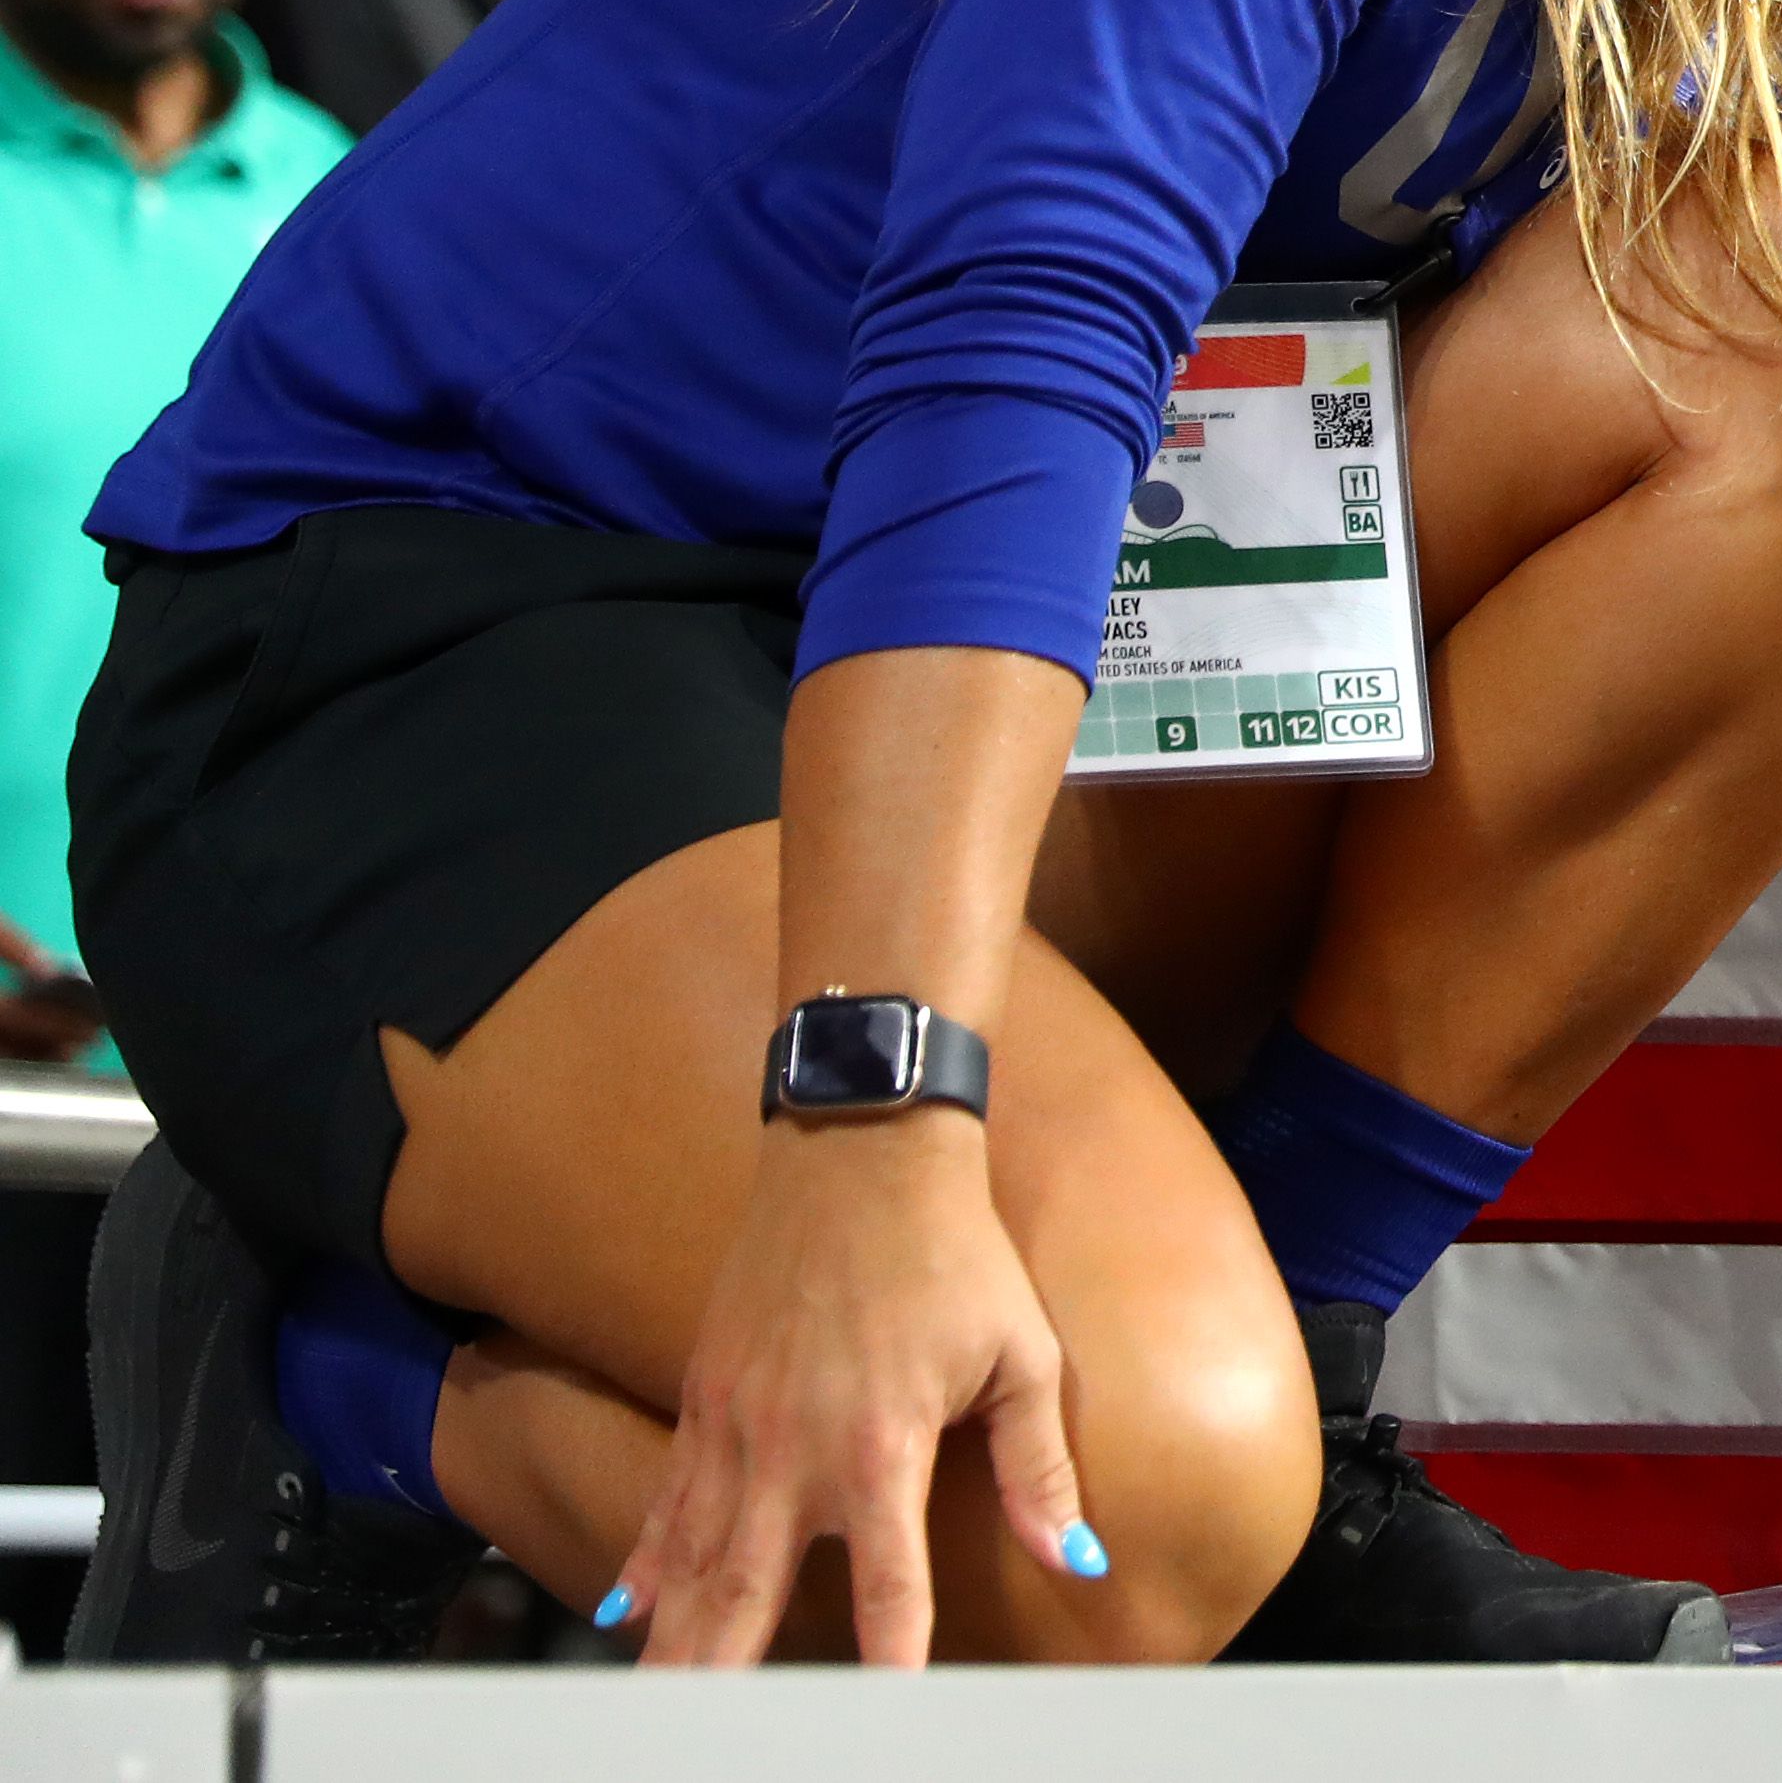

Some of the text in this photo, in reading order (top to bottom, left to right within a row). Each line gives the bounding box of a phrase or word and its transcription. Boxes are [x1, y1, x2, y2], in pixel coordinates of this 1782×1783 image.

[1209, 411, 1235, 420] AMERICA
[1347, 512, 1378, 533] BA
[1112, 645, 1152, 659] COACH
[1124, 661, 1168, 677] STATES
[1171, 661, 1184, 674] OF
[1189, 658, 1243, 673] AMERICA
[1334, 675, 1383, 700] KIS
[1166, 712, 1392, 747] 9 11 12 COR
